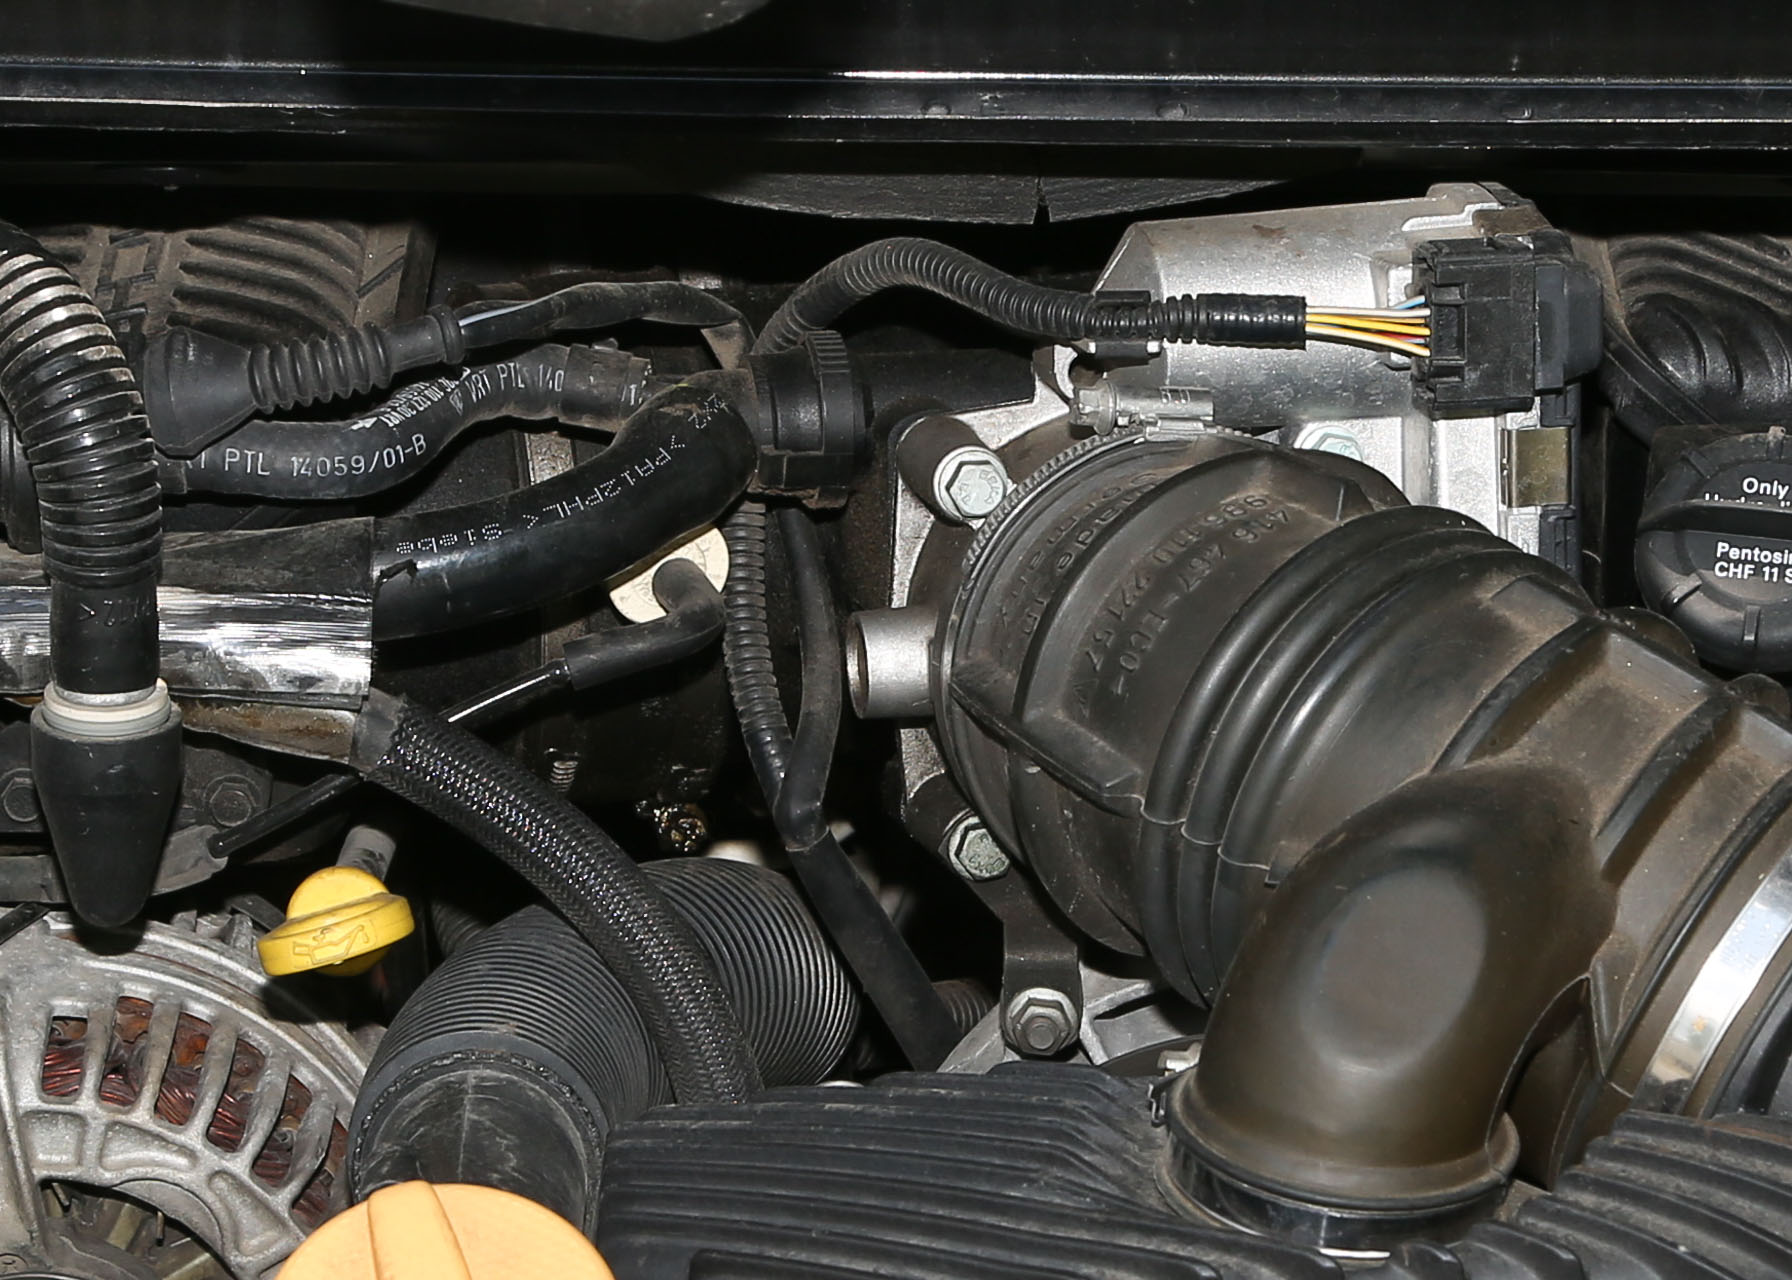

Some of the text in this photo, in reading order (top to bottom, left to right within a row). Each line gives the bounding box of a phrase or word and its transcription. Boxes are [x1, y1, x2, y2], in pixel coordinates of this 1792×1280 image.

[224, 447, 271, 476] PTL
[1742, 477, 1789, 500] Only
[1714, 561, 1756, 579] CHF
[1762, 566, 1779, 582] 11
